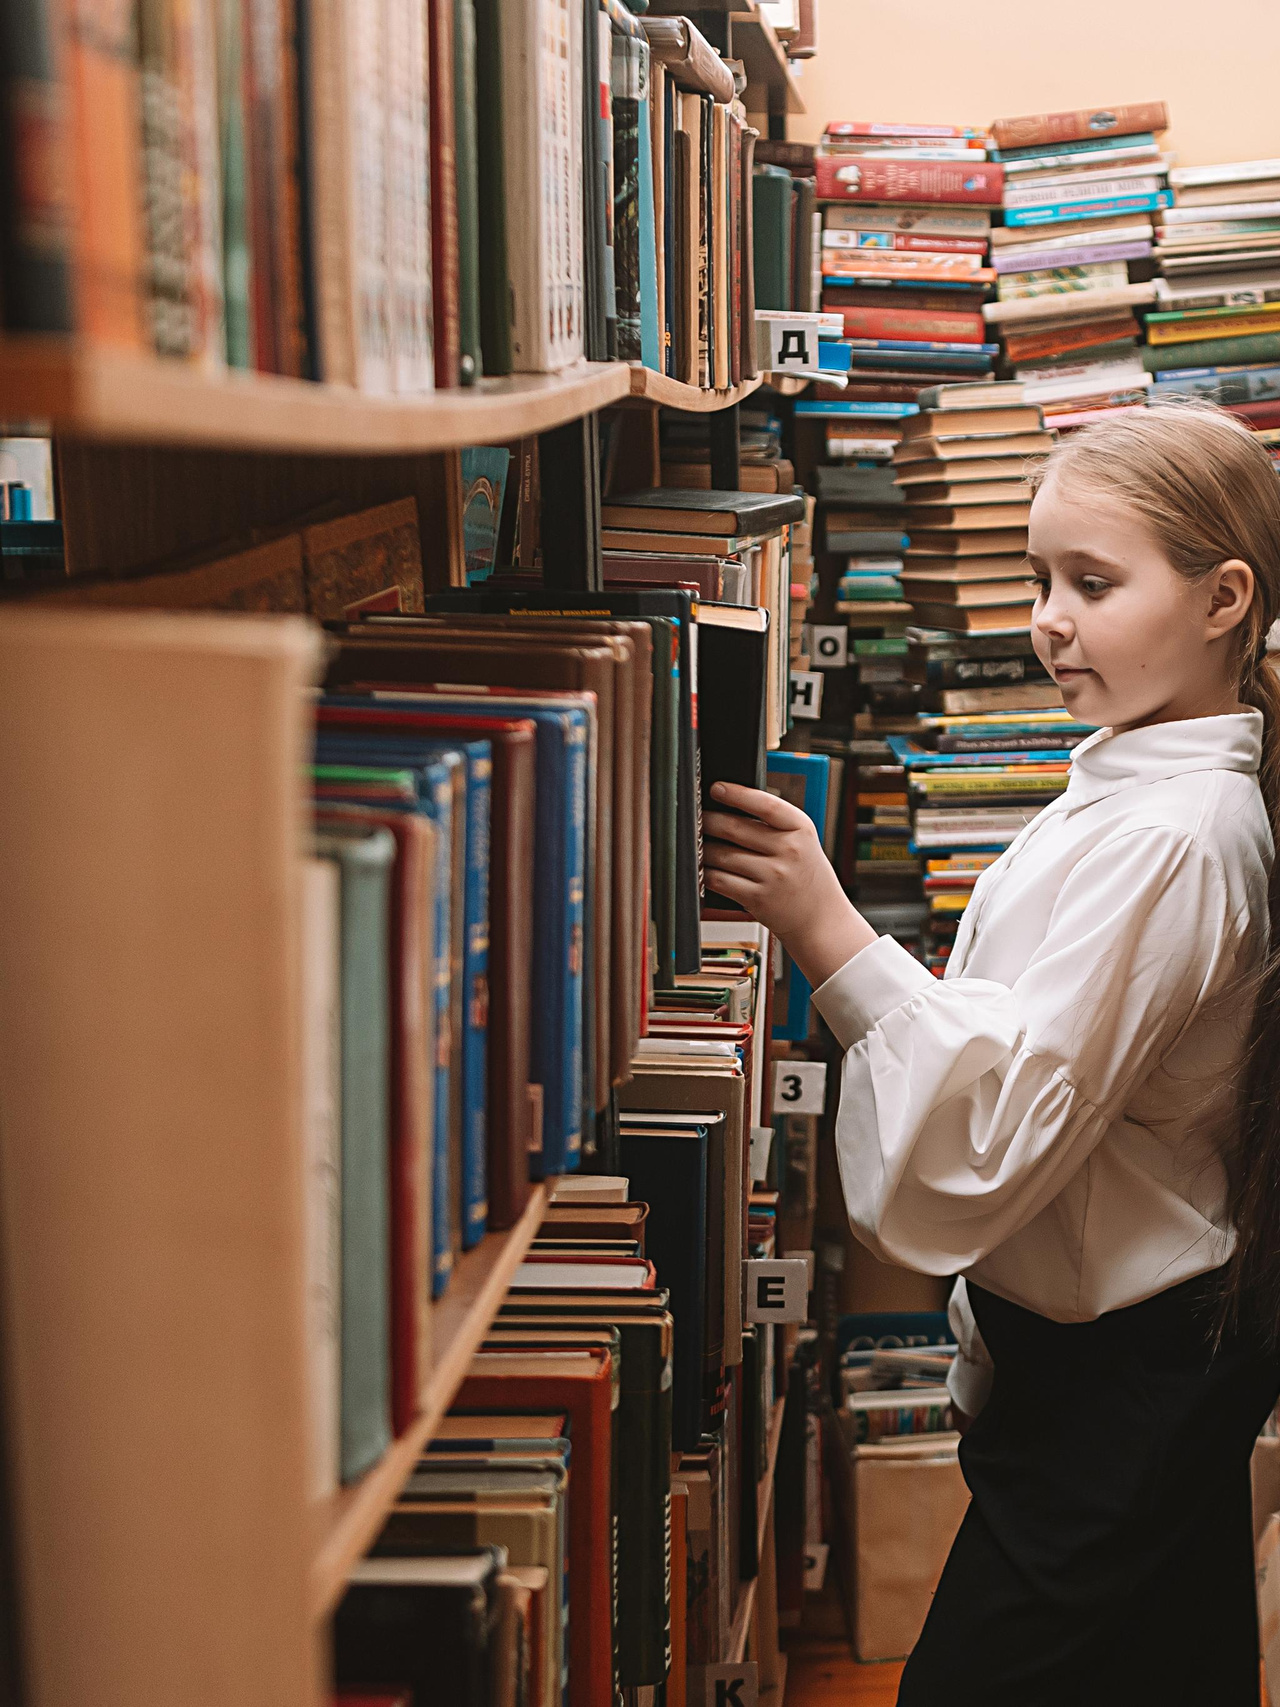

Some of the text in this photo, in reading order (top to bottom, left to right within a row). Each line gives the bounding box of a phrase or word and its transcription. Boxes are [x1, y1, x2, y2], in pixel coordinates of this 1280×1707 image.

[778, 330, 809, 364] Д
[523, 454, 532, 503] СИВКА-БУРКА
[819, 636, 840, 657] О
[790, 680, 813, 706] Н
[757, 1276, 785, 1308] Е
[715, 1678, 745, 1707] К
